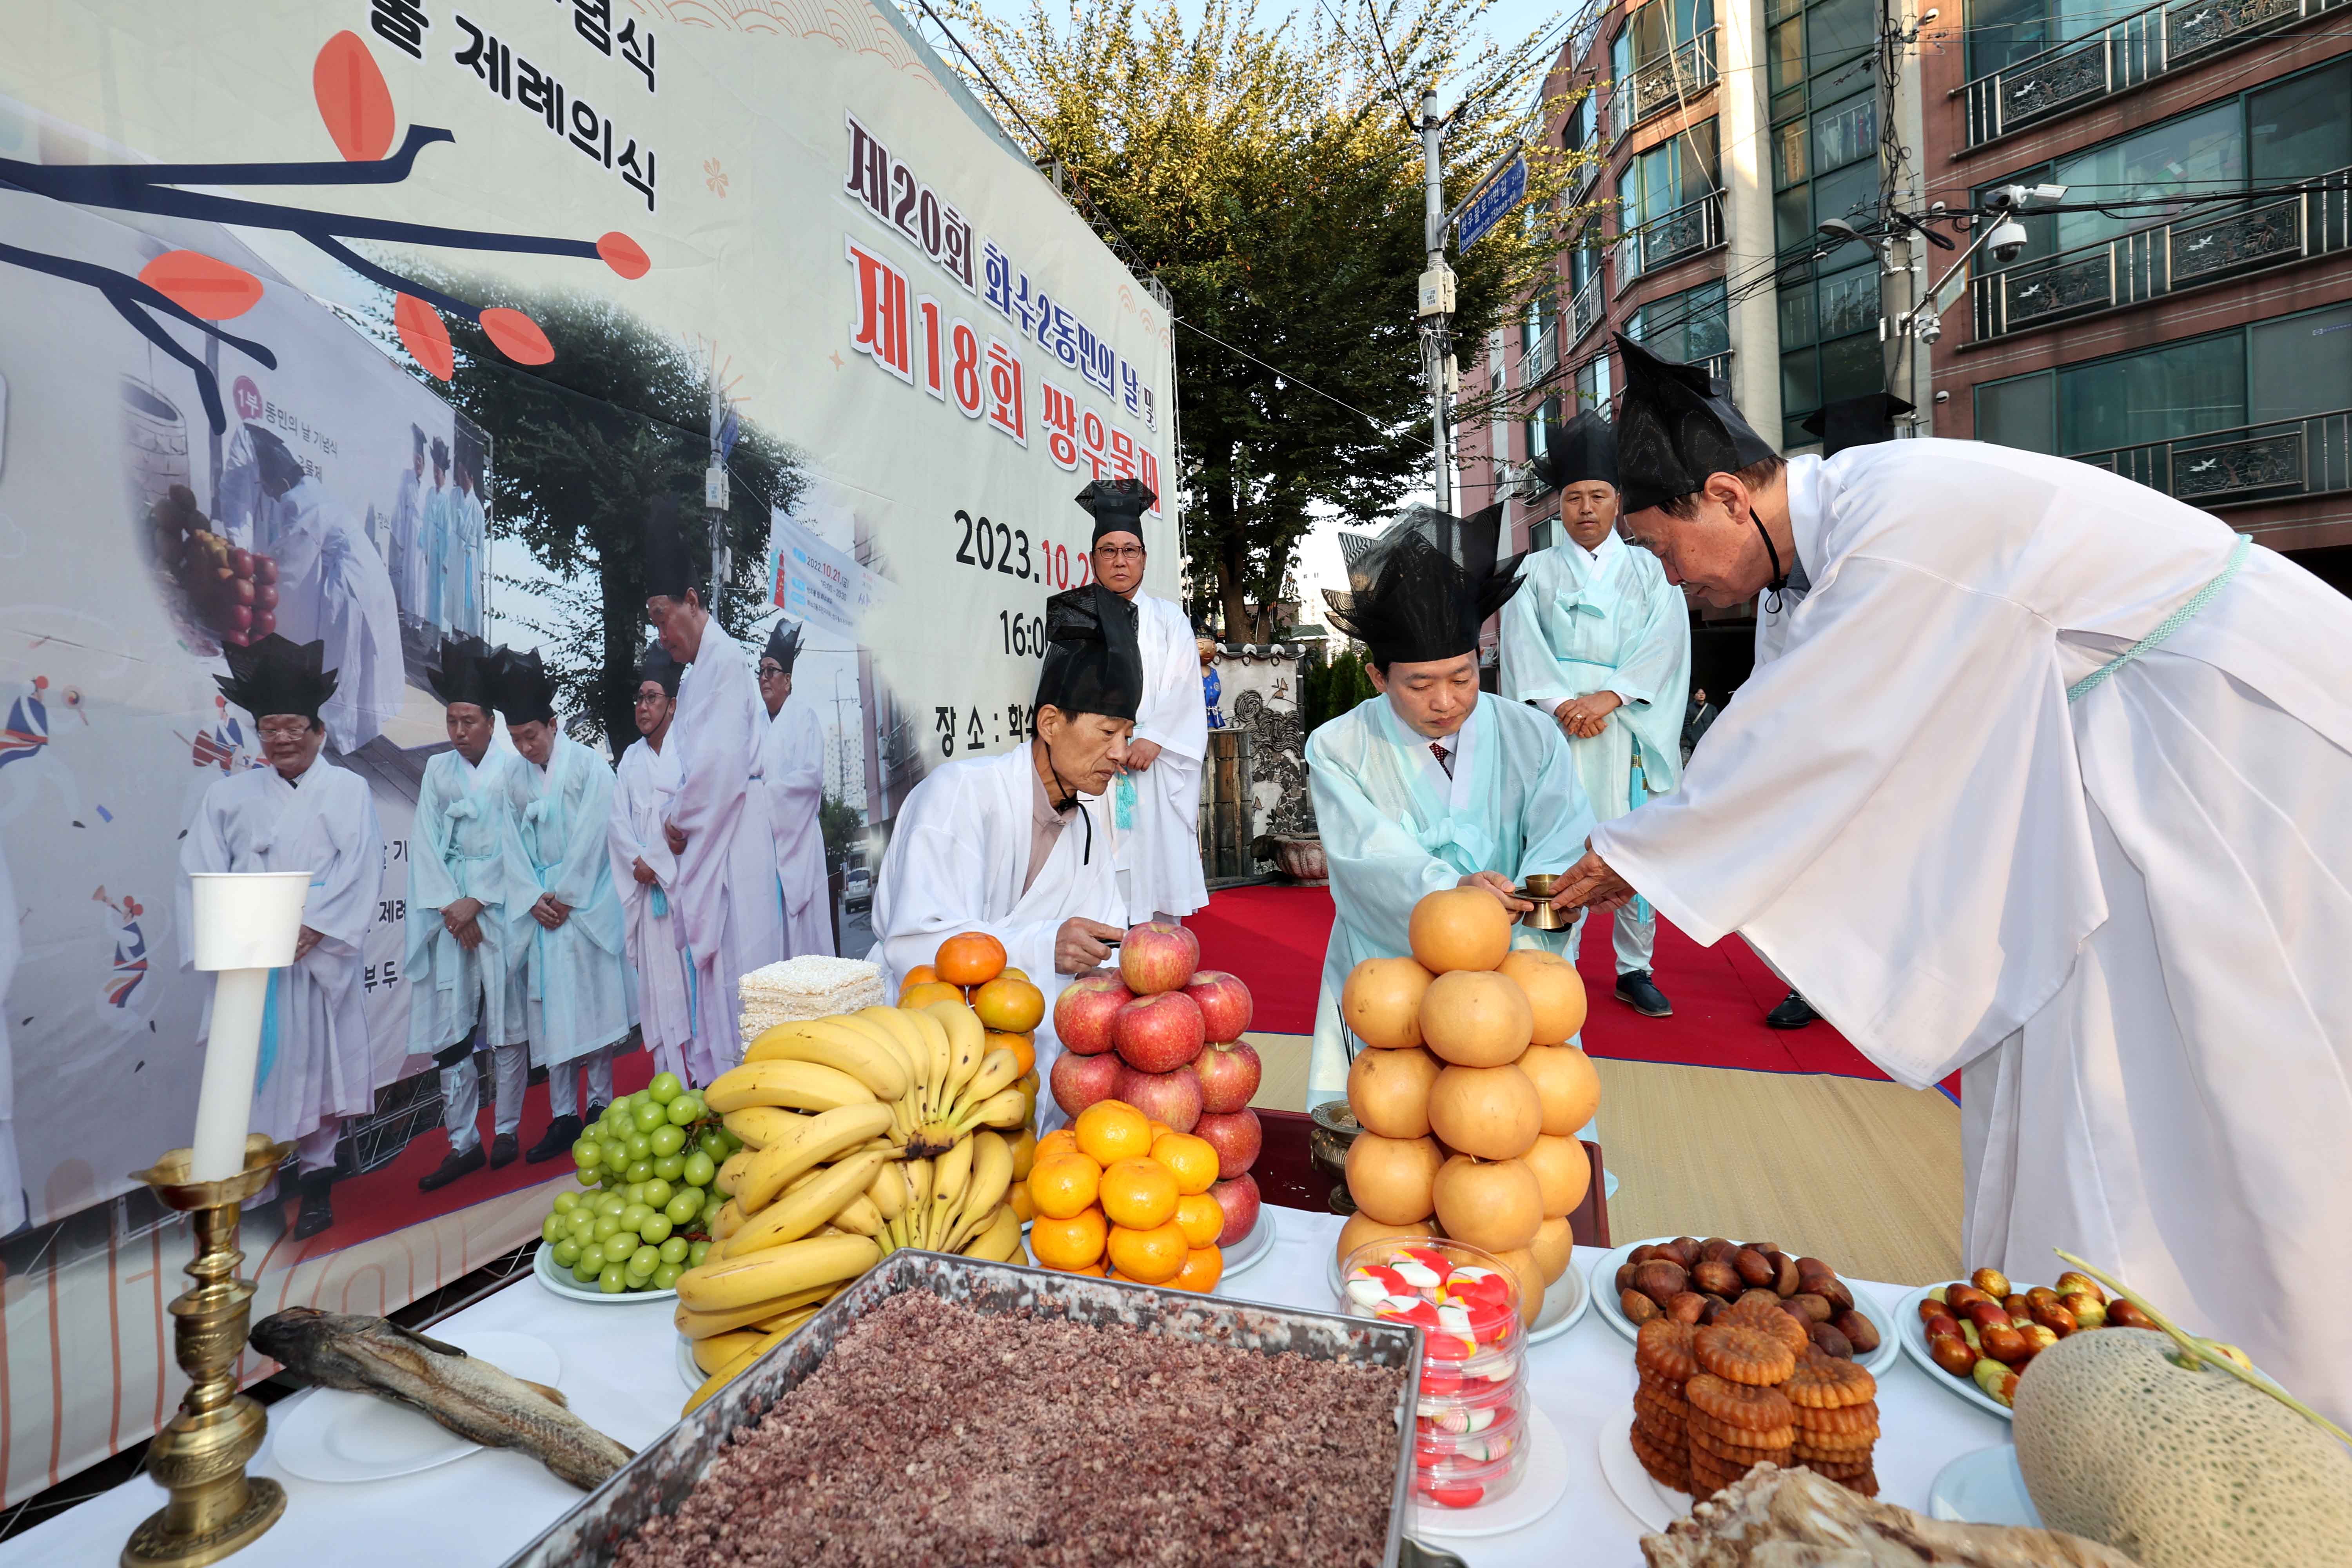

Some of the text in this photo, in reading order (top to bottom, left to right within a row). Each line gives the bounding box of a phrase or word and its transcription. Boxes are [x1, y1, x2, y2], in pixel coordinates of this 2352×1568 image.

[556, 0, 654, 93] 념식
[455, 15, 654, 212] 제례의식
[1461, 177, 1507, 235] 쌍우물로73번길
[1461, 189, 1516, 250] Ssangumul-ro 73beon-gil
[847, 117, 1154, 428] 제20회 화수2동민의 날 및
[849, 245, 1025, 440] 제18회
[238, 388, 338, 460] 1부 동민의 날 기념식
[954, 509, 1097, 591] 2023.10.2
[1000, 610, 1047, 659] 16:0
